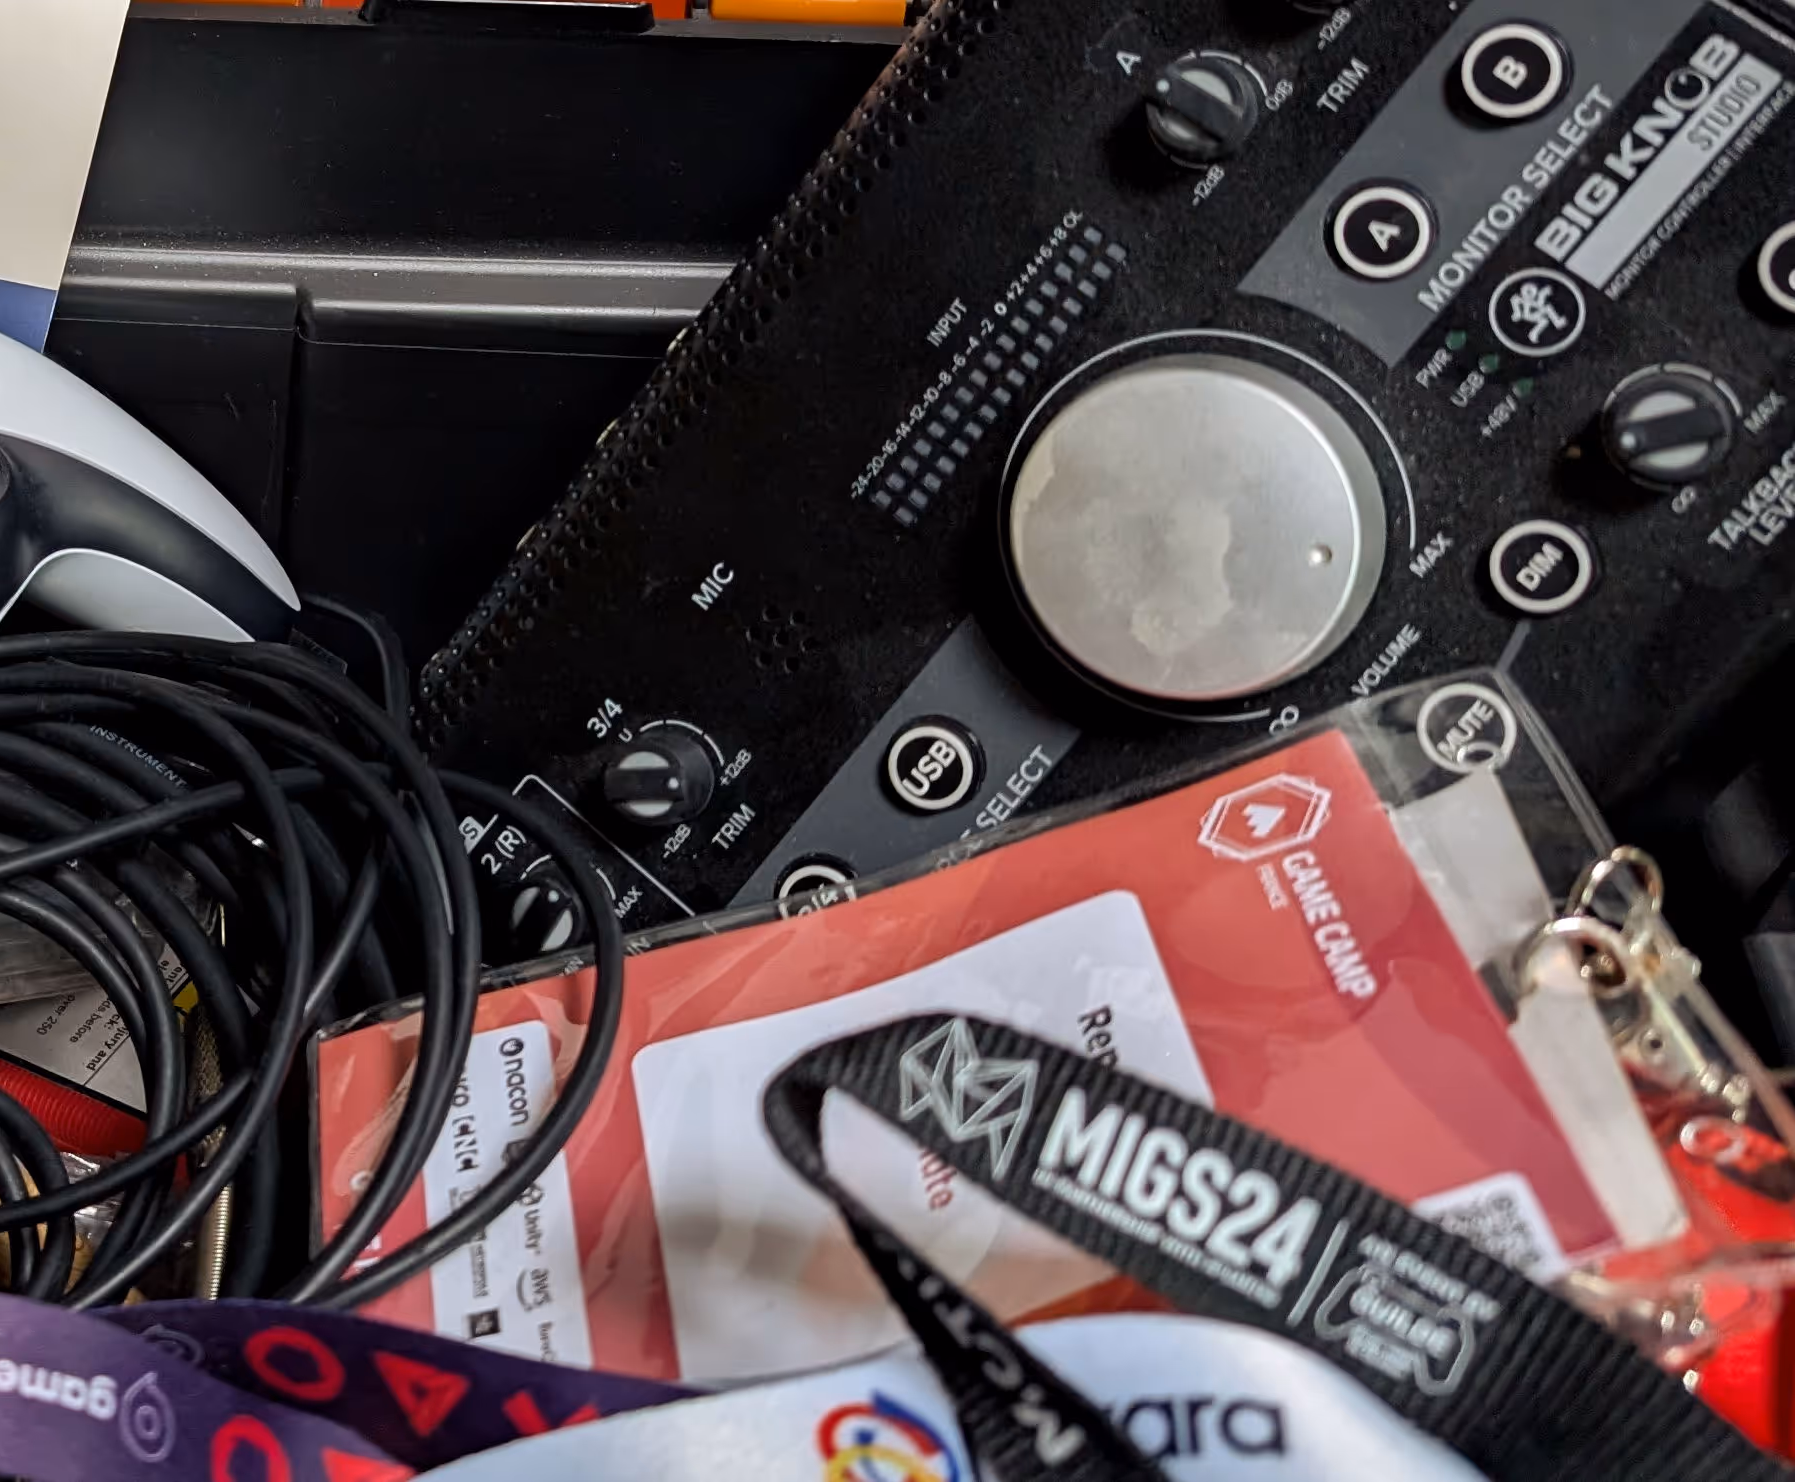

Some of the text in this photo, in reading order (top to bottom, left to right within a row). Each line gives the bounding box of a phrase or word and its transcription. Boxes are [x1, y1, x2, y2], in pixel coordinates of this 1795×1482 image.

[1115, 48, 1142, 76] A
[1316, 58, 1371, 114] TRIM
[1492, 55, 1530, 91] B
[1687, 73, 1762, 152] STUDIO
[1534, 33, 1741, 262] BIG KNOB
[1417, 83, 1615, 315] MONITOR SELECT
[1367, 219, 1402, 253] A
[925, 296, 969, 350] INPUT
[1416, 348, 1453, 389] PWR
[1450, 370, 1486, 409] USB
[1743, 390, 1787, 435] MAX
[1707, 442, 1795, 551] TALKBAC
[1408, 531, 1455, 580] MAX
[1515, 541, 1565, 592] DIM
[690, 561, 736, 612] MIC
[1350, 622, 1423, 699] VOLUME
[586, 697, 625, 740] 3/4
[1435, 699, 1495, 759] MUTE
[88, 723, 190, 791] INSTRUMENT
[901, 739, 958, 798] USB
[975, 743, 1055, 831] SELECT
[710, 802, 758, 853] TRIM
[612, 885, 644, 919] MAX
[1281, 850, 1378, 1001] GAME CAMP
[85, 1049, 107, 1072] and
[504, 1056, 531, 1127] nacon
[1039, 1086, 1324, 1287] MIGS24
